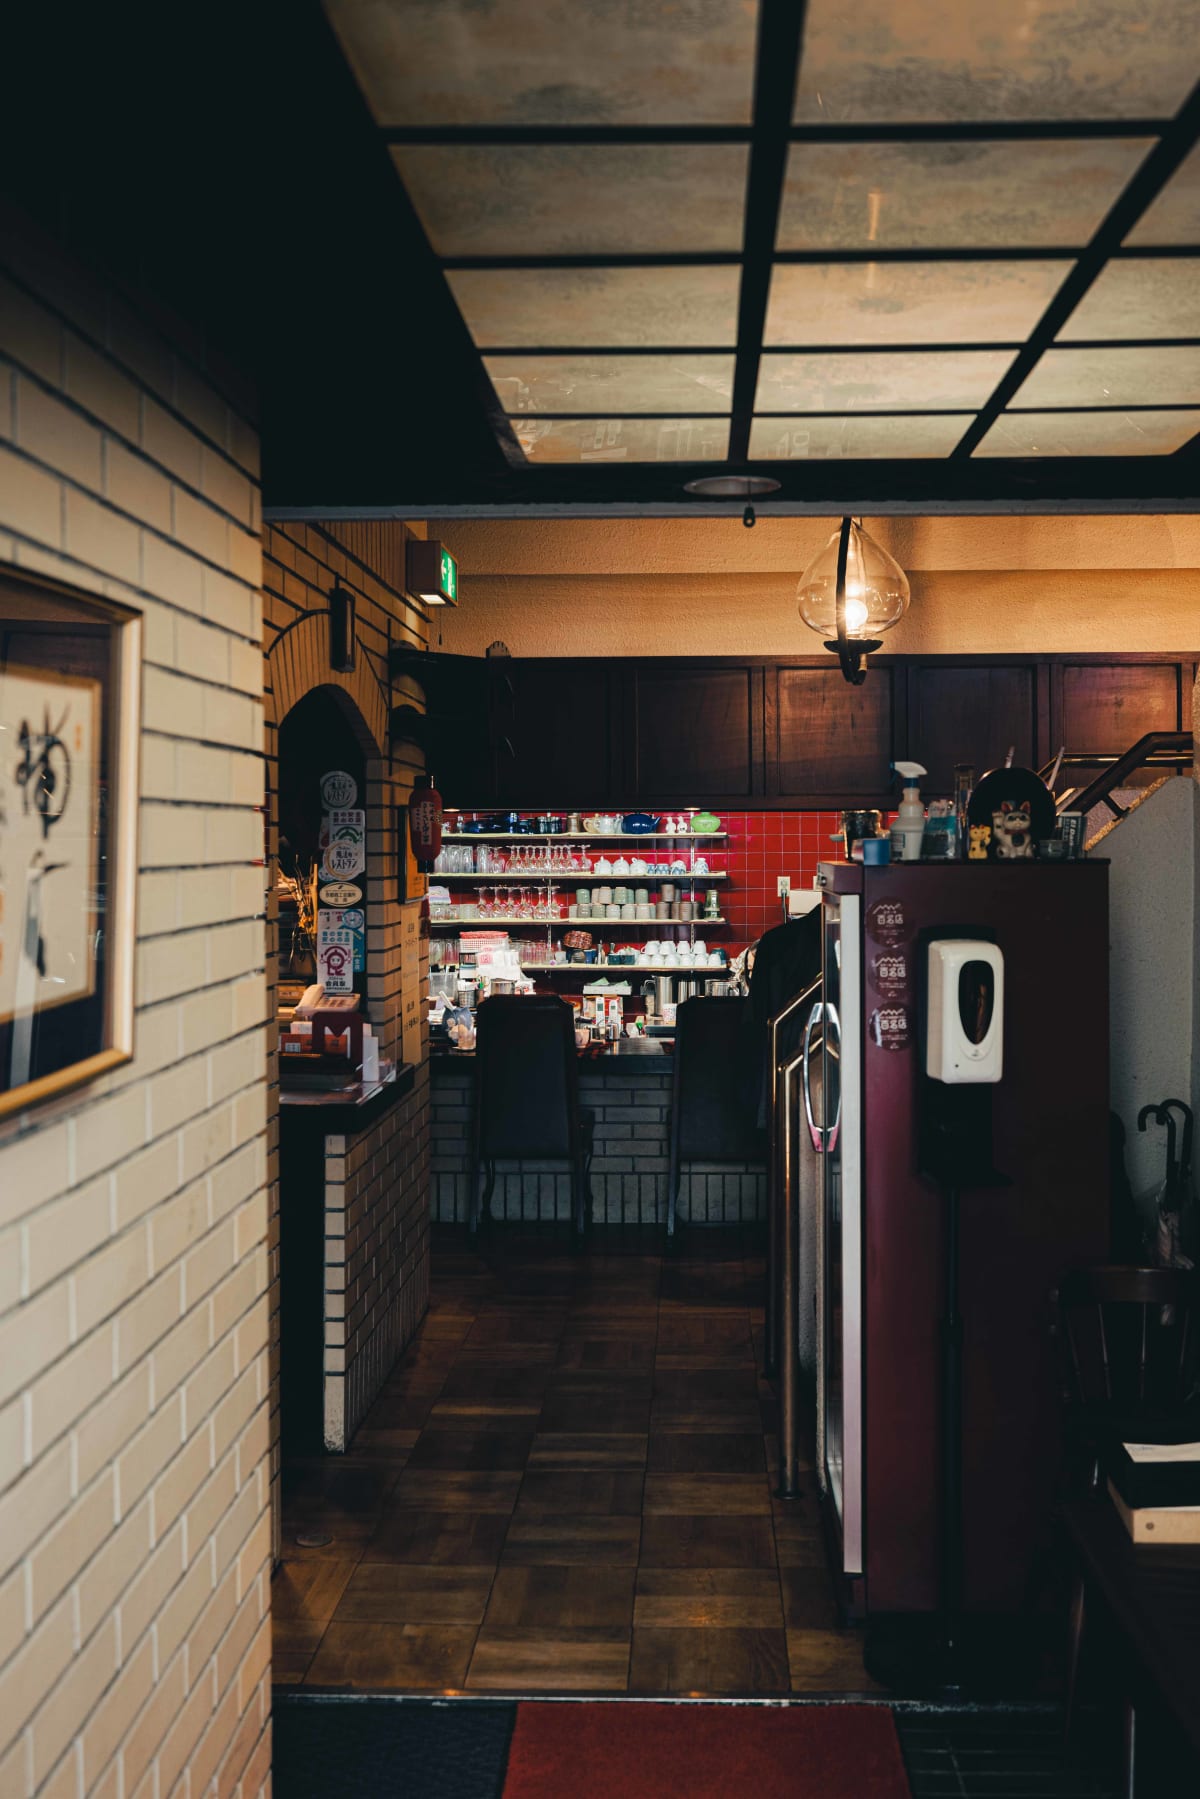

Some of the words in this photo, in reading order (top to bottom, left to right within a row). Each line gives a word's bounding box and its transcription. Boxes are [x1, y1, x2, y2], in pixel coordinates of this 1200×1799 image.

[332, 859, 357, 869] レストラン
[877, 914, 904, 925] 百名店
[879, 967, 906, 978] 百名店
[880, 1019, 907, 1030] 百名店
